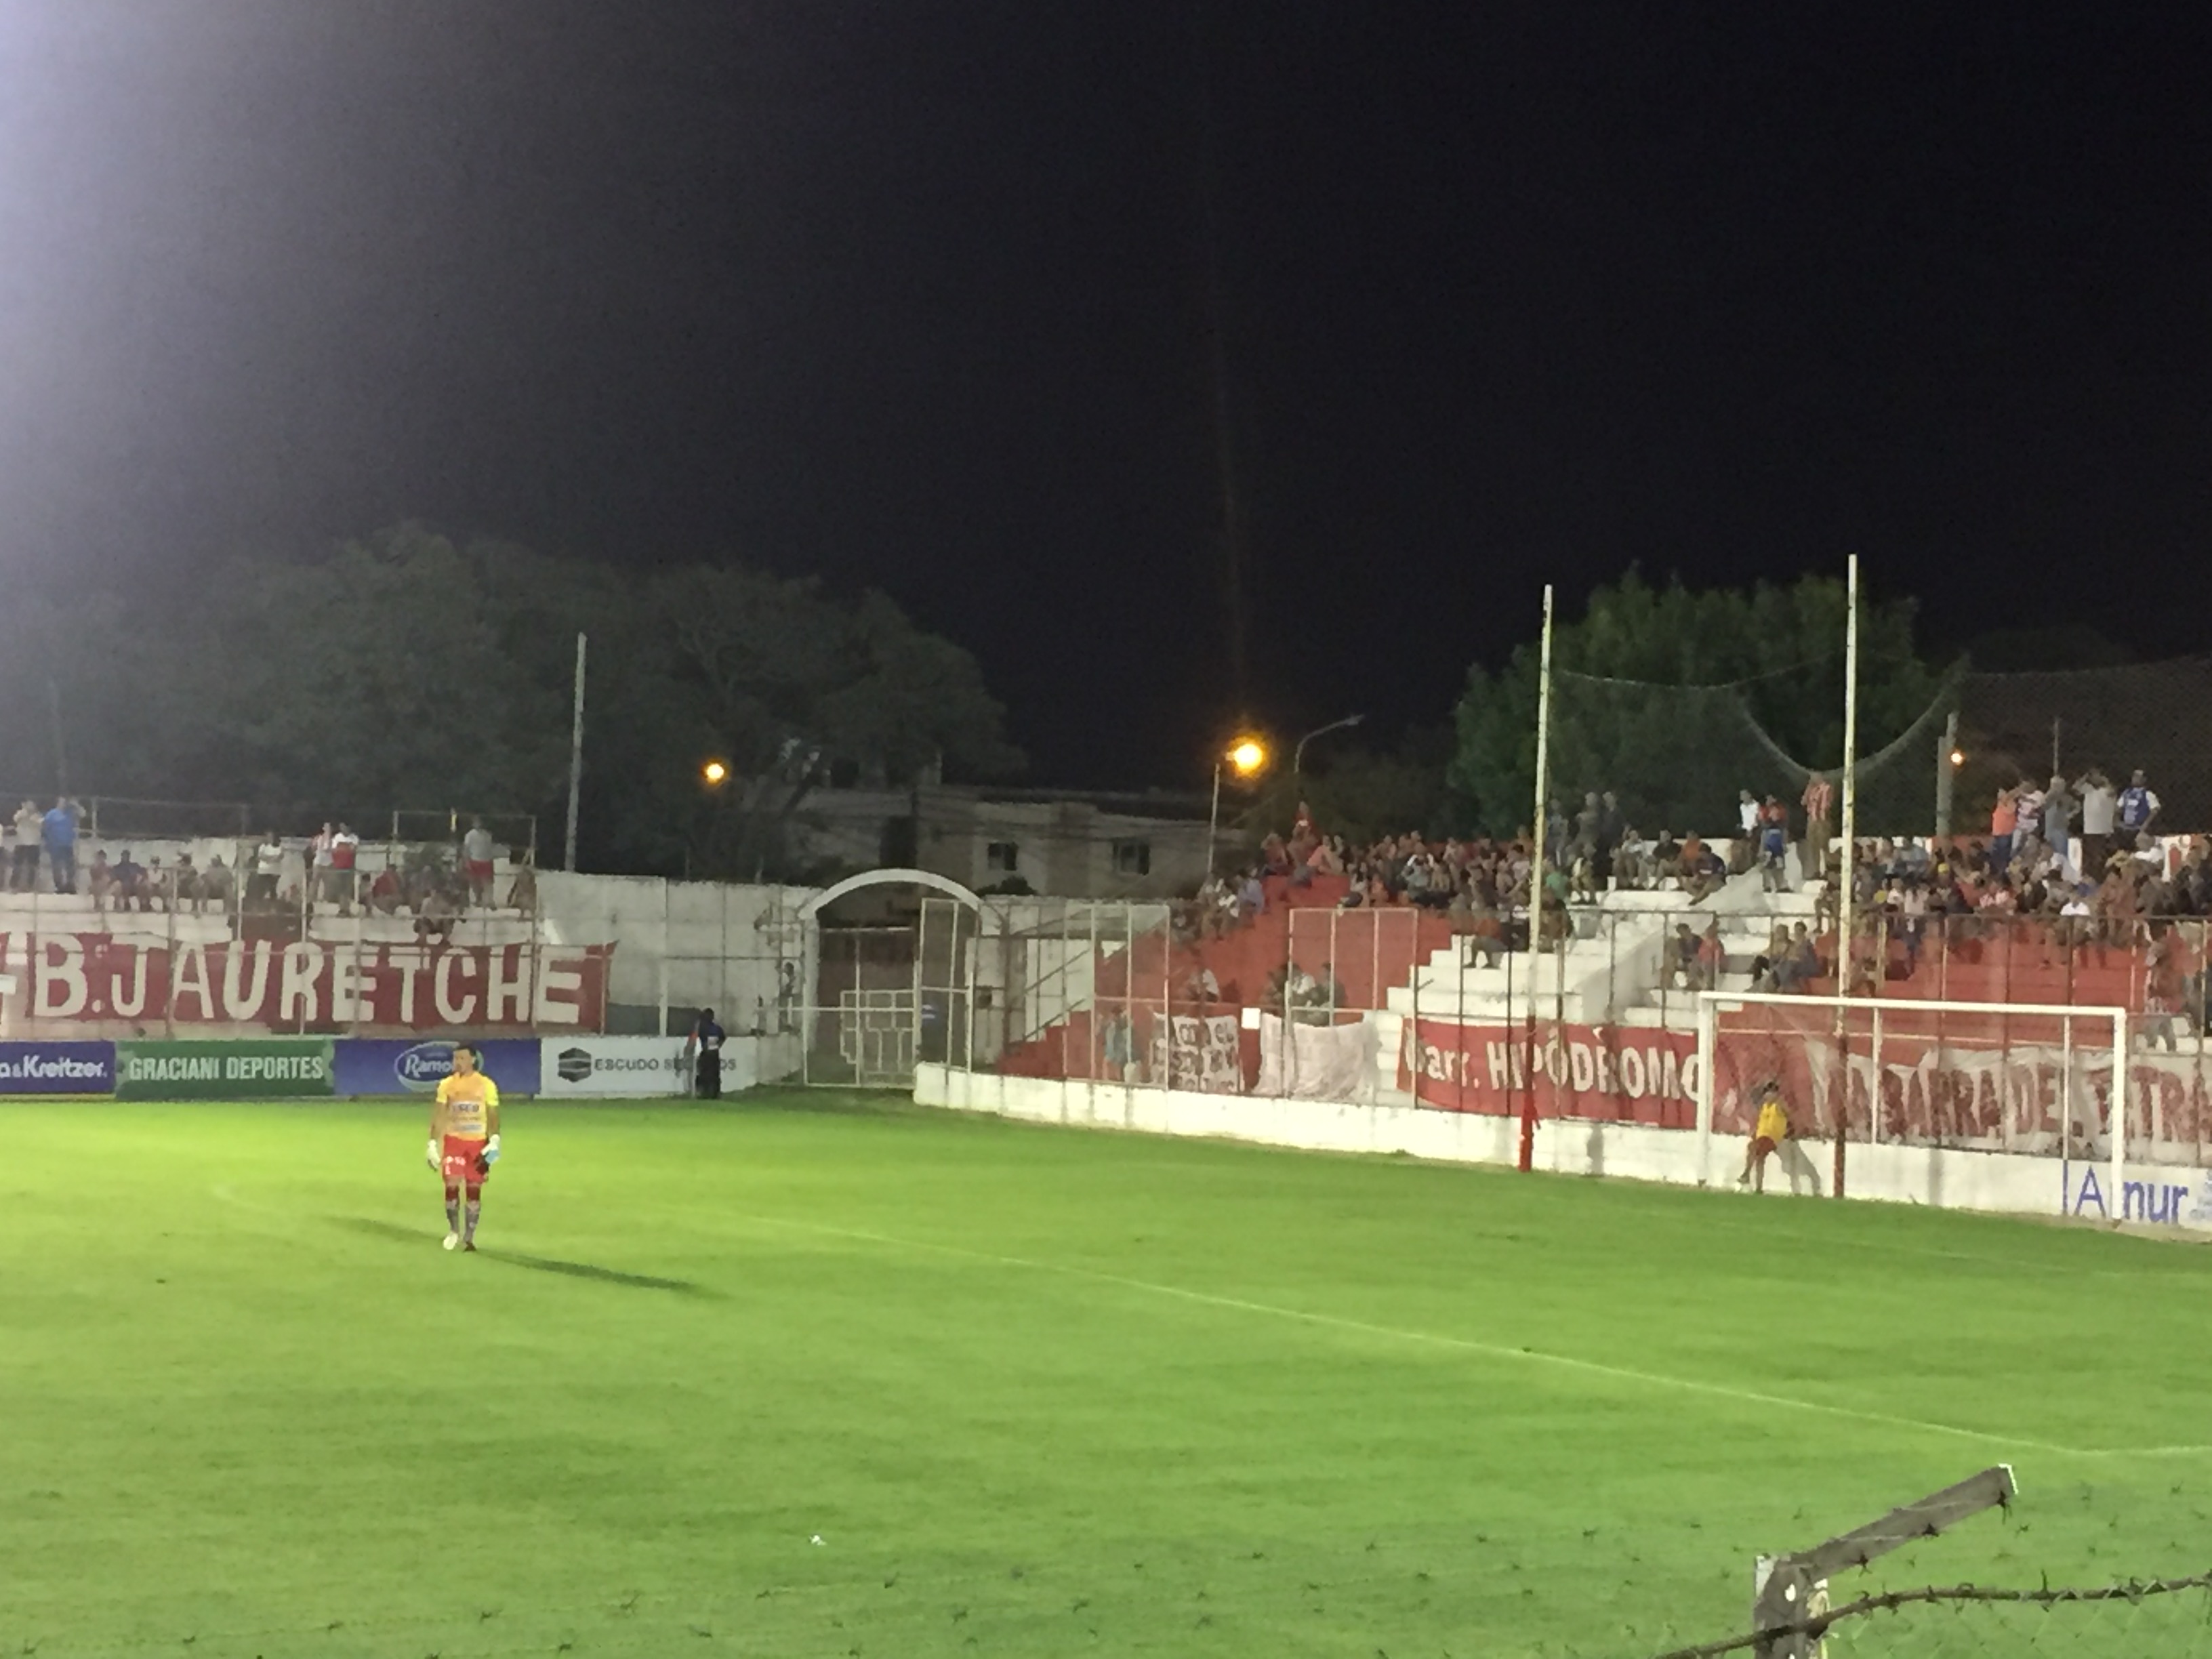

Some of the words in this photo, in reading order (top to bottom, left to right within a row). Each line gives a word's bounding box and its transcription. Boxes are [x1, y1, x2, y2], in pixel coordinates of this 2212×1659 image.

[129, 1056, 220, 1081] GRACIANI
[226, 1055, 324, 1081] DEPORTES
[594, 1058, 659, 1071] ESCUDO
